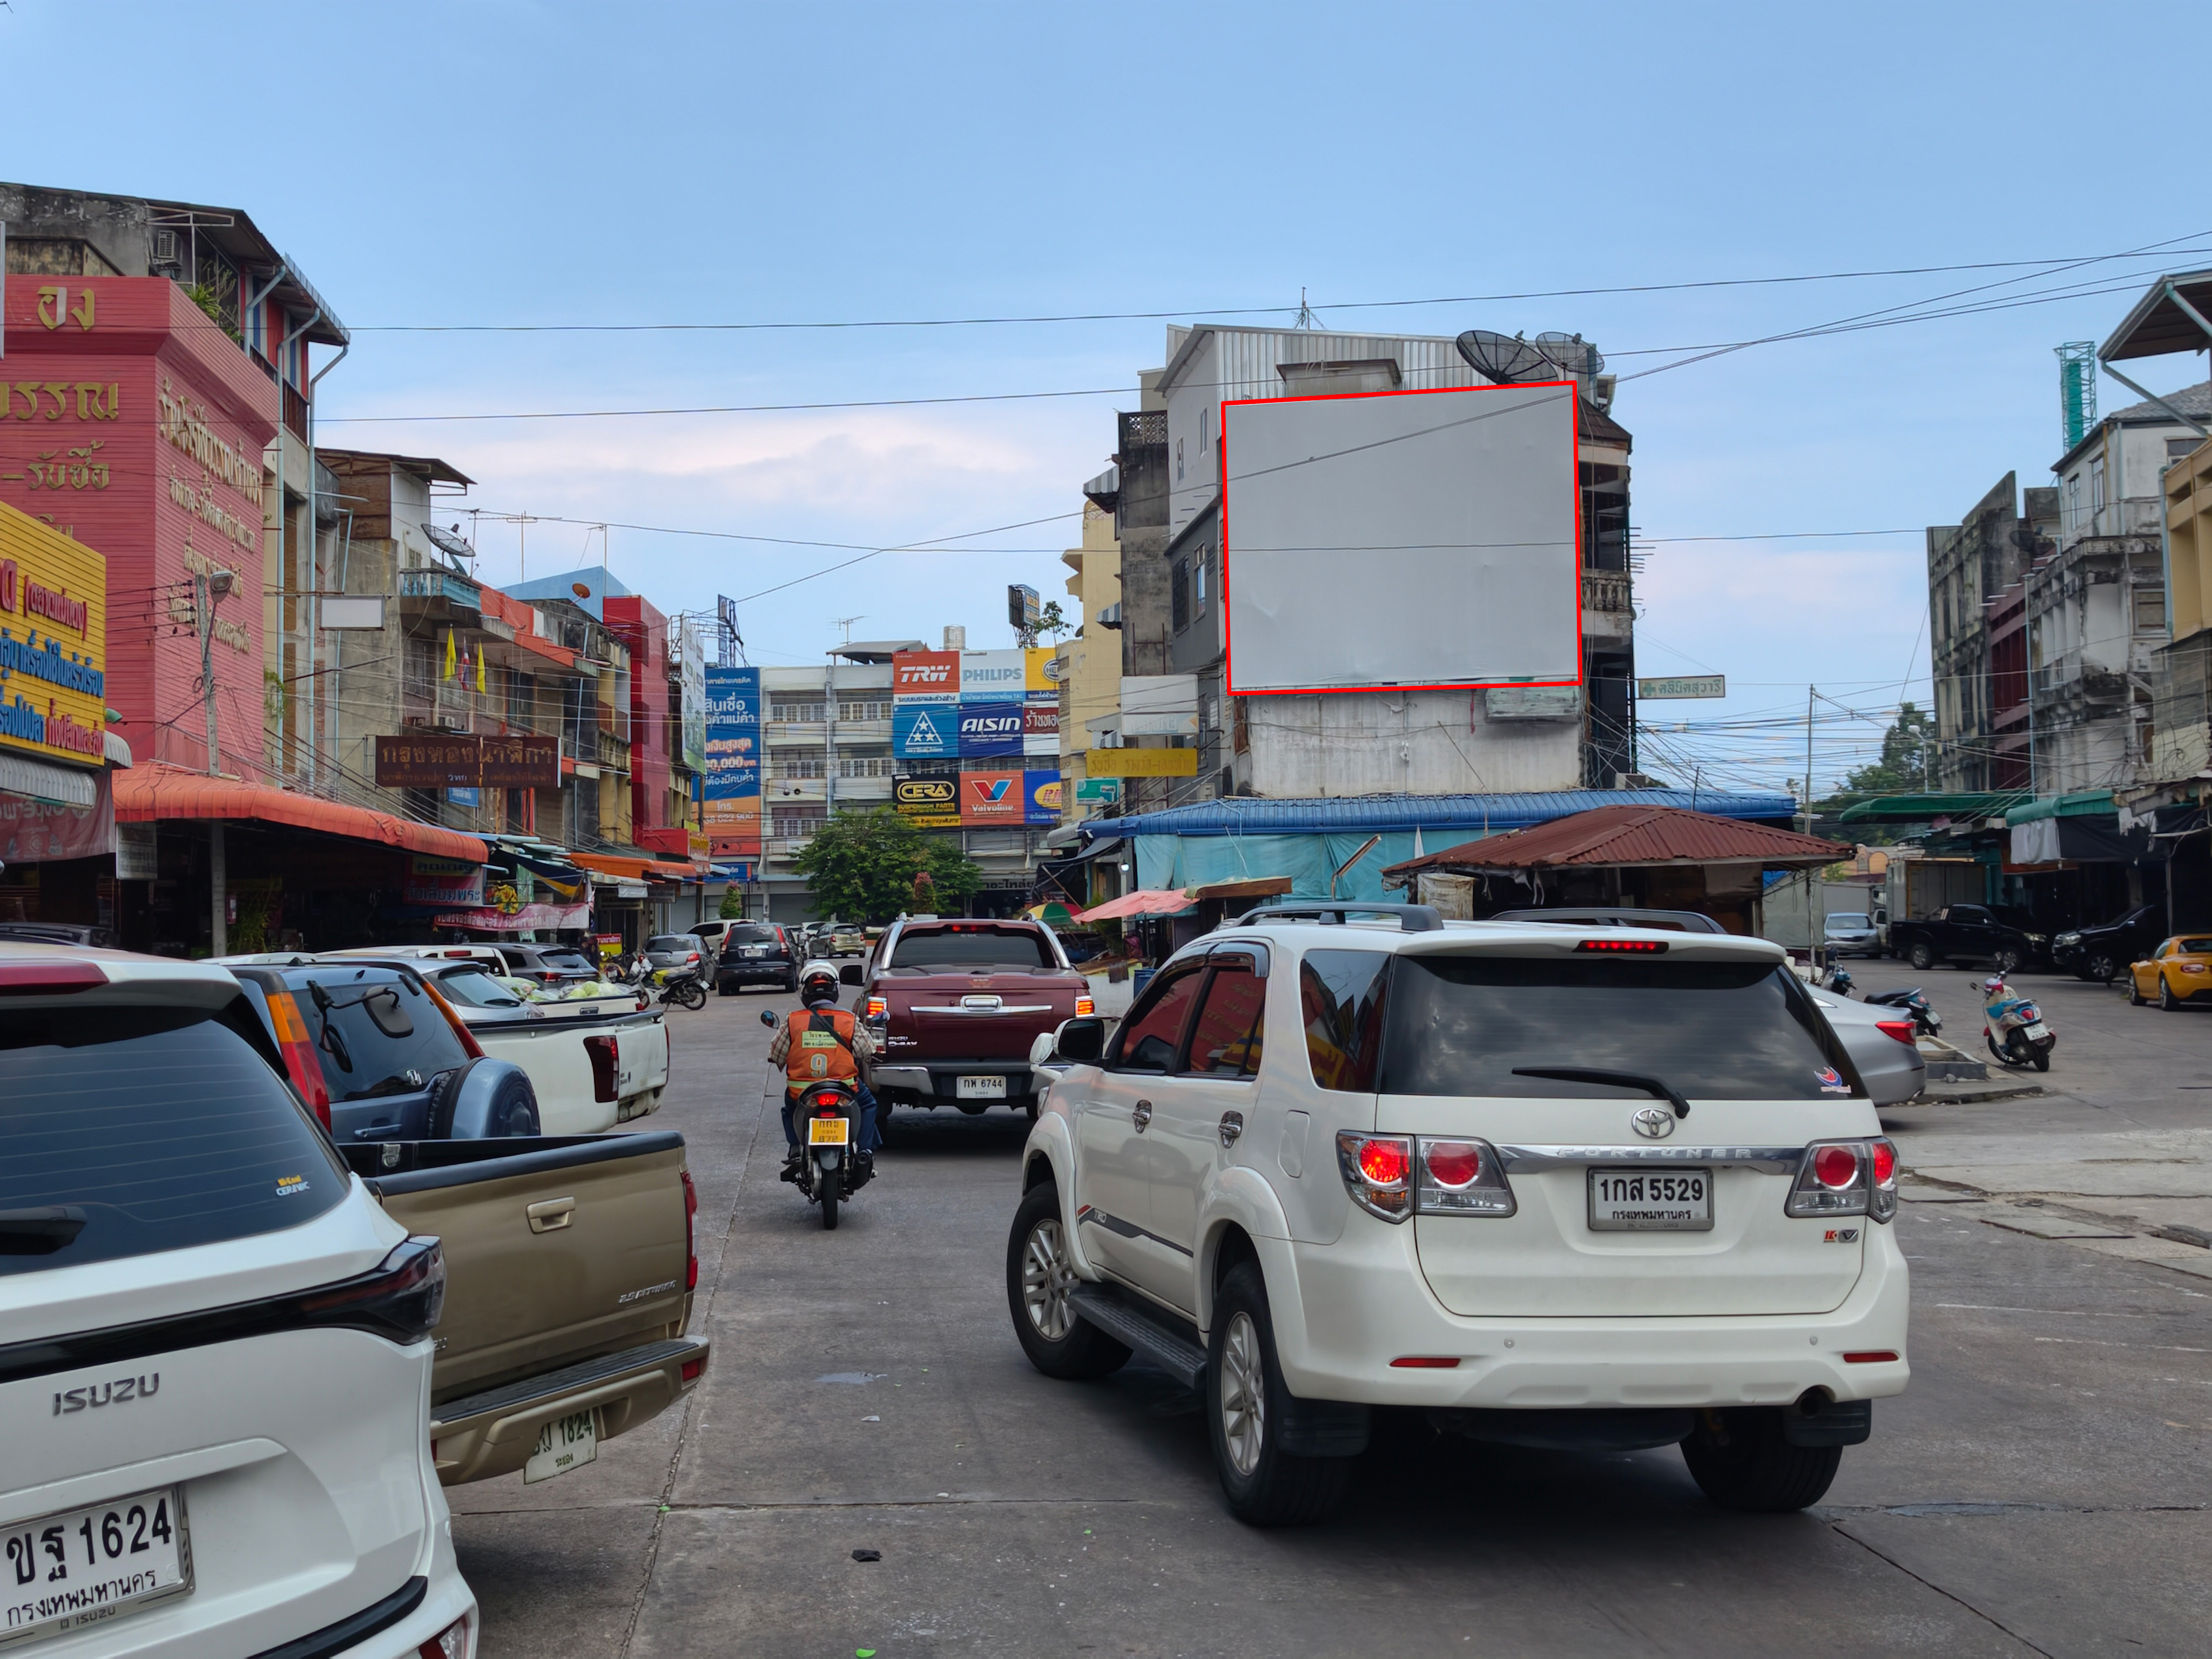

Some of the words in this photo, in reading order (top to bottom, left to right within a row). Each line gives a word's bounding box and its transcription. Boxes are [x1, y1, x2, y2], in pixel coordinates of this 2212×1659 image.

[900, 665, 951, 683] TRW
[963, 667, 1022, 682] PHILIPS
[961, 717, 1021, 732] AISIN
[901, 784, 949, 798] CERA
[811, 1053, 828, 1077] 9
[981, 1078, 1002, 1088] 6744
[1557, 1148, 1752, 1159] FORTUNER
[1600, 1176, 1644, 1202] 1กส
[1649, 1178, 1703, 1202] 5529
[1612, 1209, 1692, 1220] กรงเทพมหานคร
[52, 1372, 160, 1417] ISUZU
[558, 1407, 592, 1446] 1824
[6, 1525, 68, 1586] ขฐ
[79, 1498, 172, 1566] 1624
[7, 1569, 156, 1627] กรงเทพมหานคร
[76, 1605, 116, 1626] ISUZU
